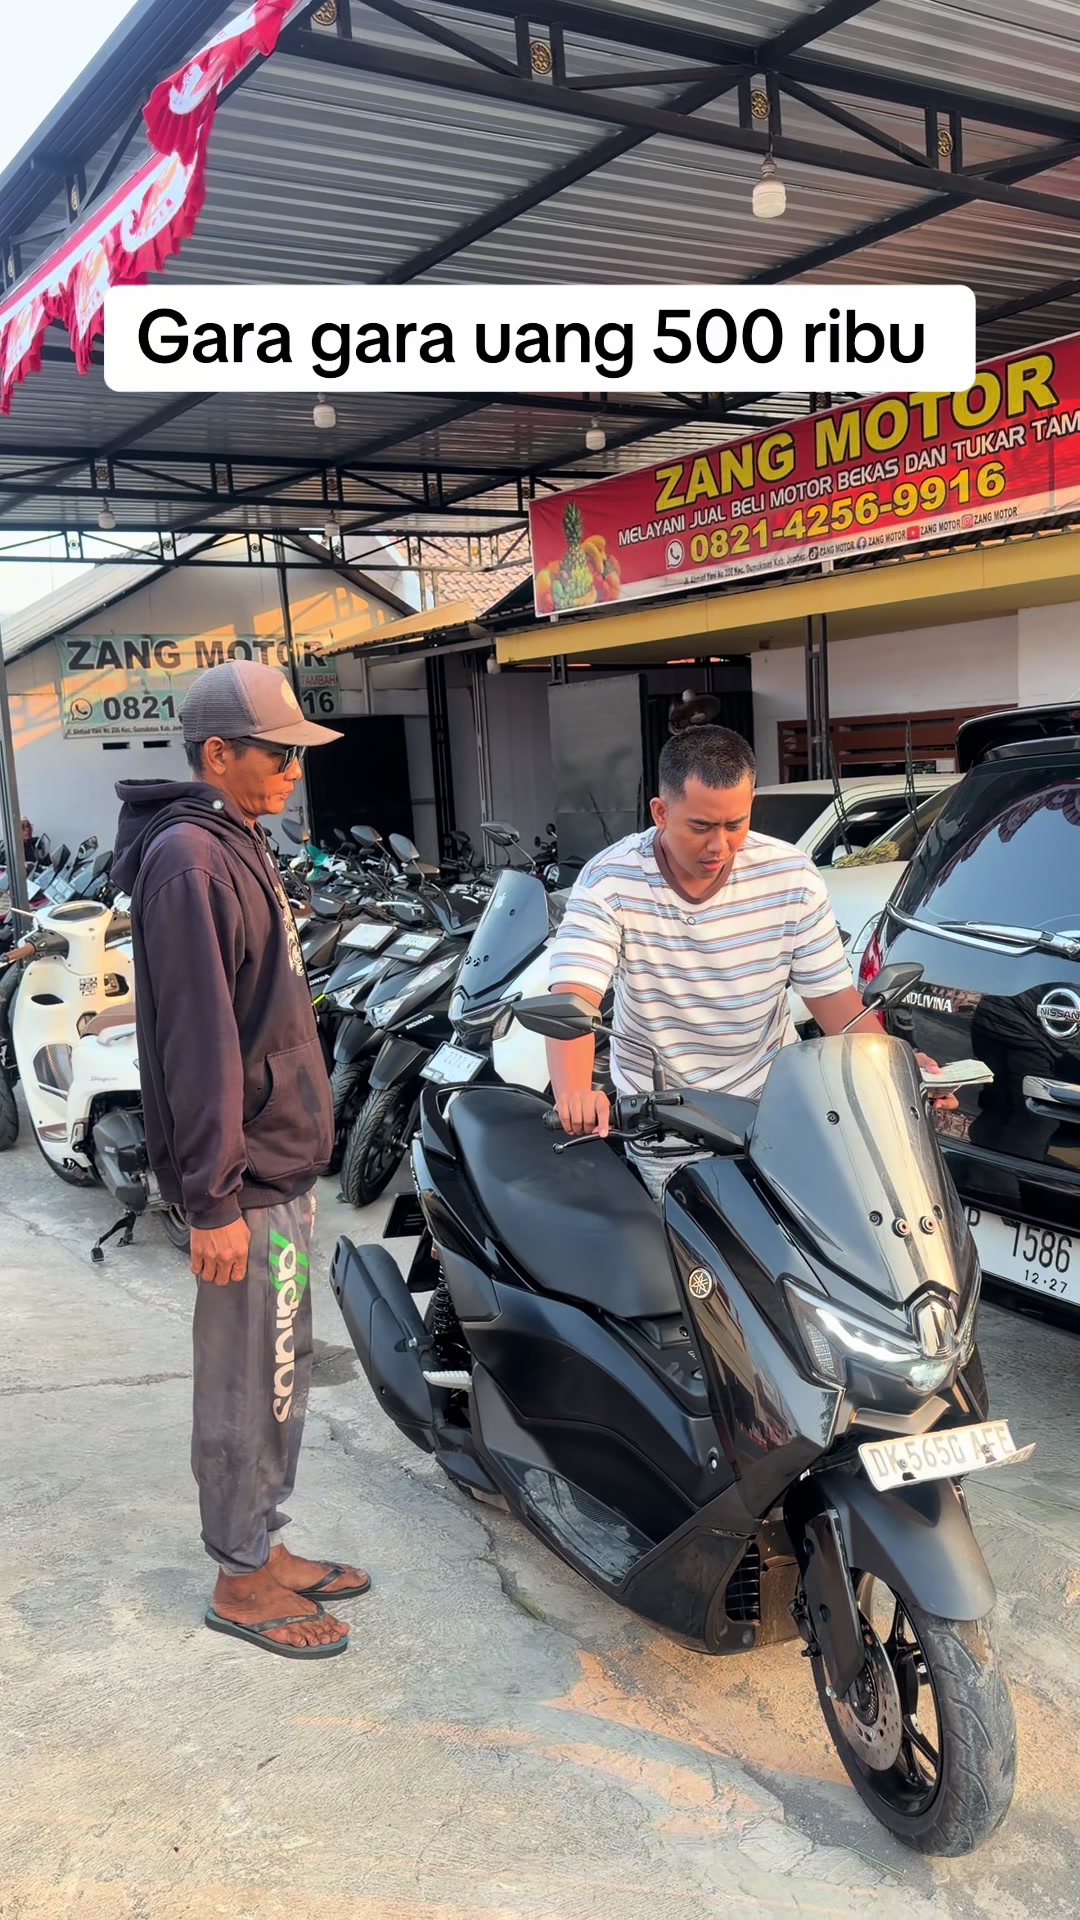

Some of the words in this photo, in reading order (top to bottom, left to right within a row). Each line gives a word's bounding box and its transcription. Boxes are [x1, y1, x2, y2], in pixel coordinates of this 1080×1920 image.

[654, 432, 796, 513] ZANG
[814, 353, 1059, 469] MOTOR
[617, 515, 686, 547] MELAYANI
[689, 504, 726, 530] JUAL
[731, 491, 766, 518] BELI
[769, 475, 833, 509] MOTOR
[837, 457, 900, 491] BEKAS
[904, 445, 947, 474] DAN
[952, 425, 1026, 462] TUKAR
[1031, 409, 1080, 442] TAM
[689, 462, 1007, 564] 0821-4256-9916
[868, 534, 884, 547] ZANG
[885, 529, 906, 542] MOTOR
[920, 524, 937, 536] ZANG
[938, 518, 961, 532] MOTOR
[973, 511, 992, 525] ZANG
[994, 506, 1018, 520] MOTOR
[66, 640, 181, 671] ZANG
[195, 639, 327, 669] MOTOR
[309, 974, 331, 986] ONDA
[405, 1014, 435, 1030] HONDA
[1040, 1007, 1080, 1021] NISSAN
[1011, 1221, 1073, 1273] 1586
[868, 1444, 902, 1478] DK
